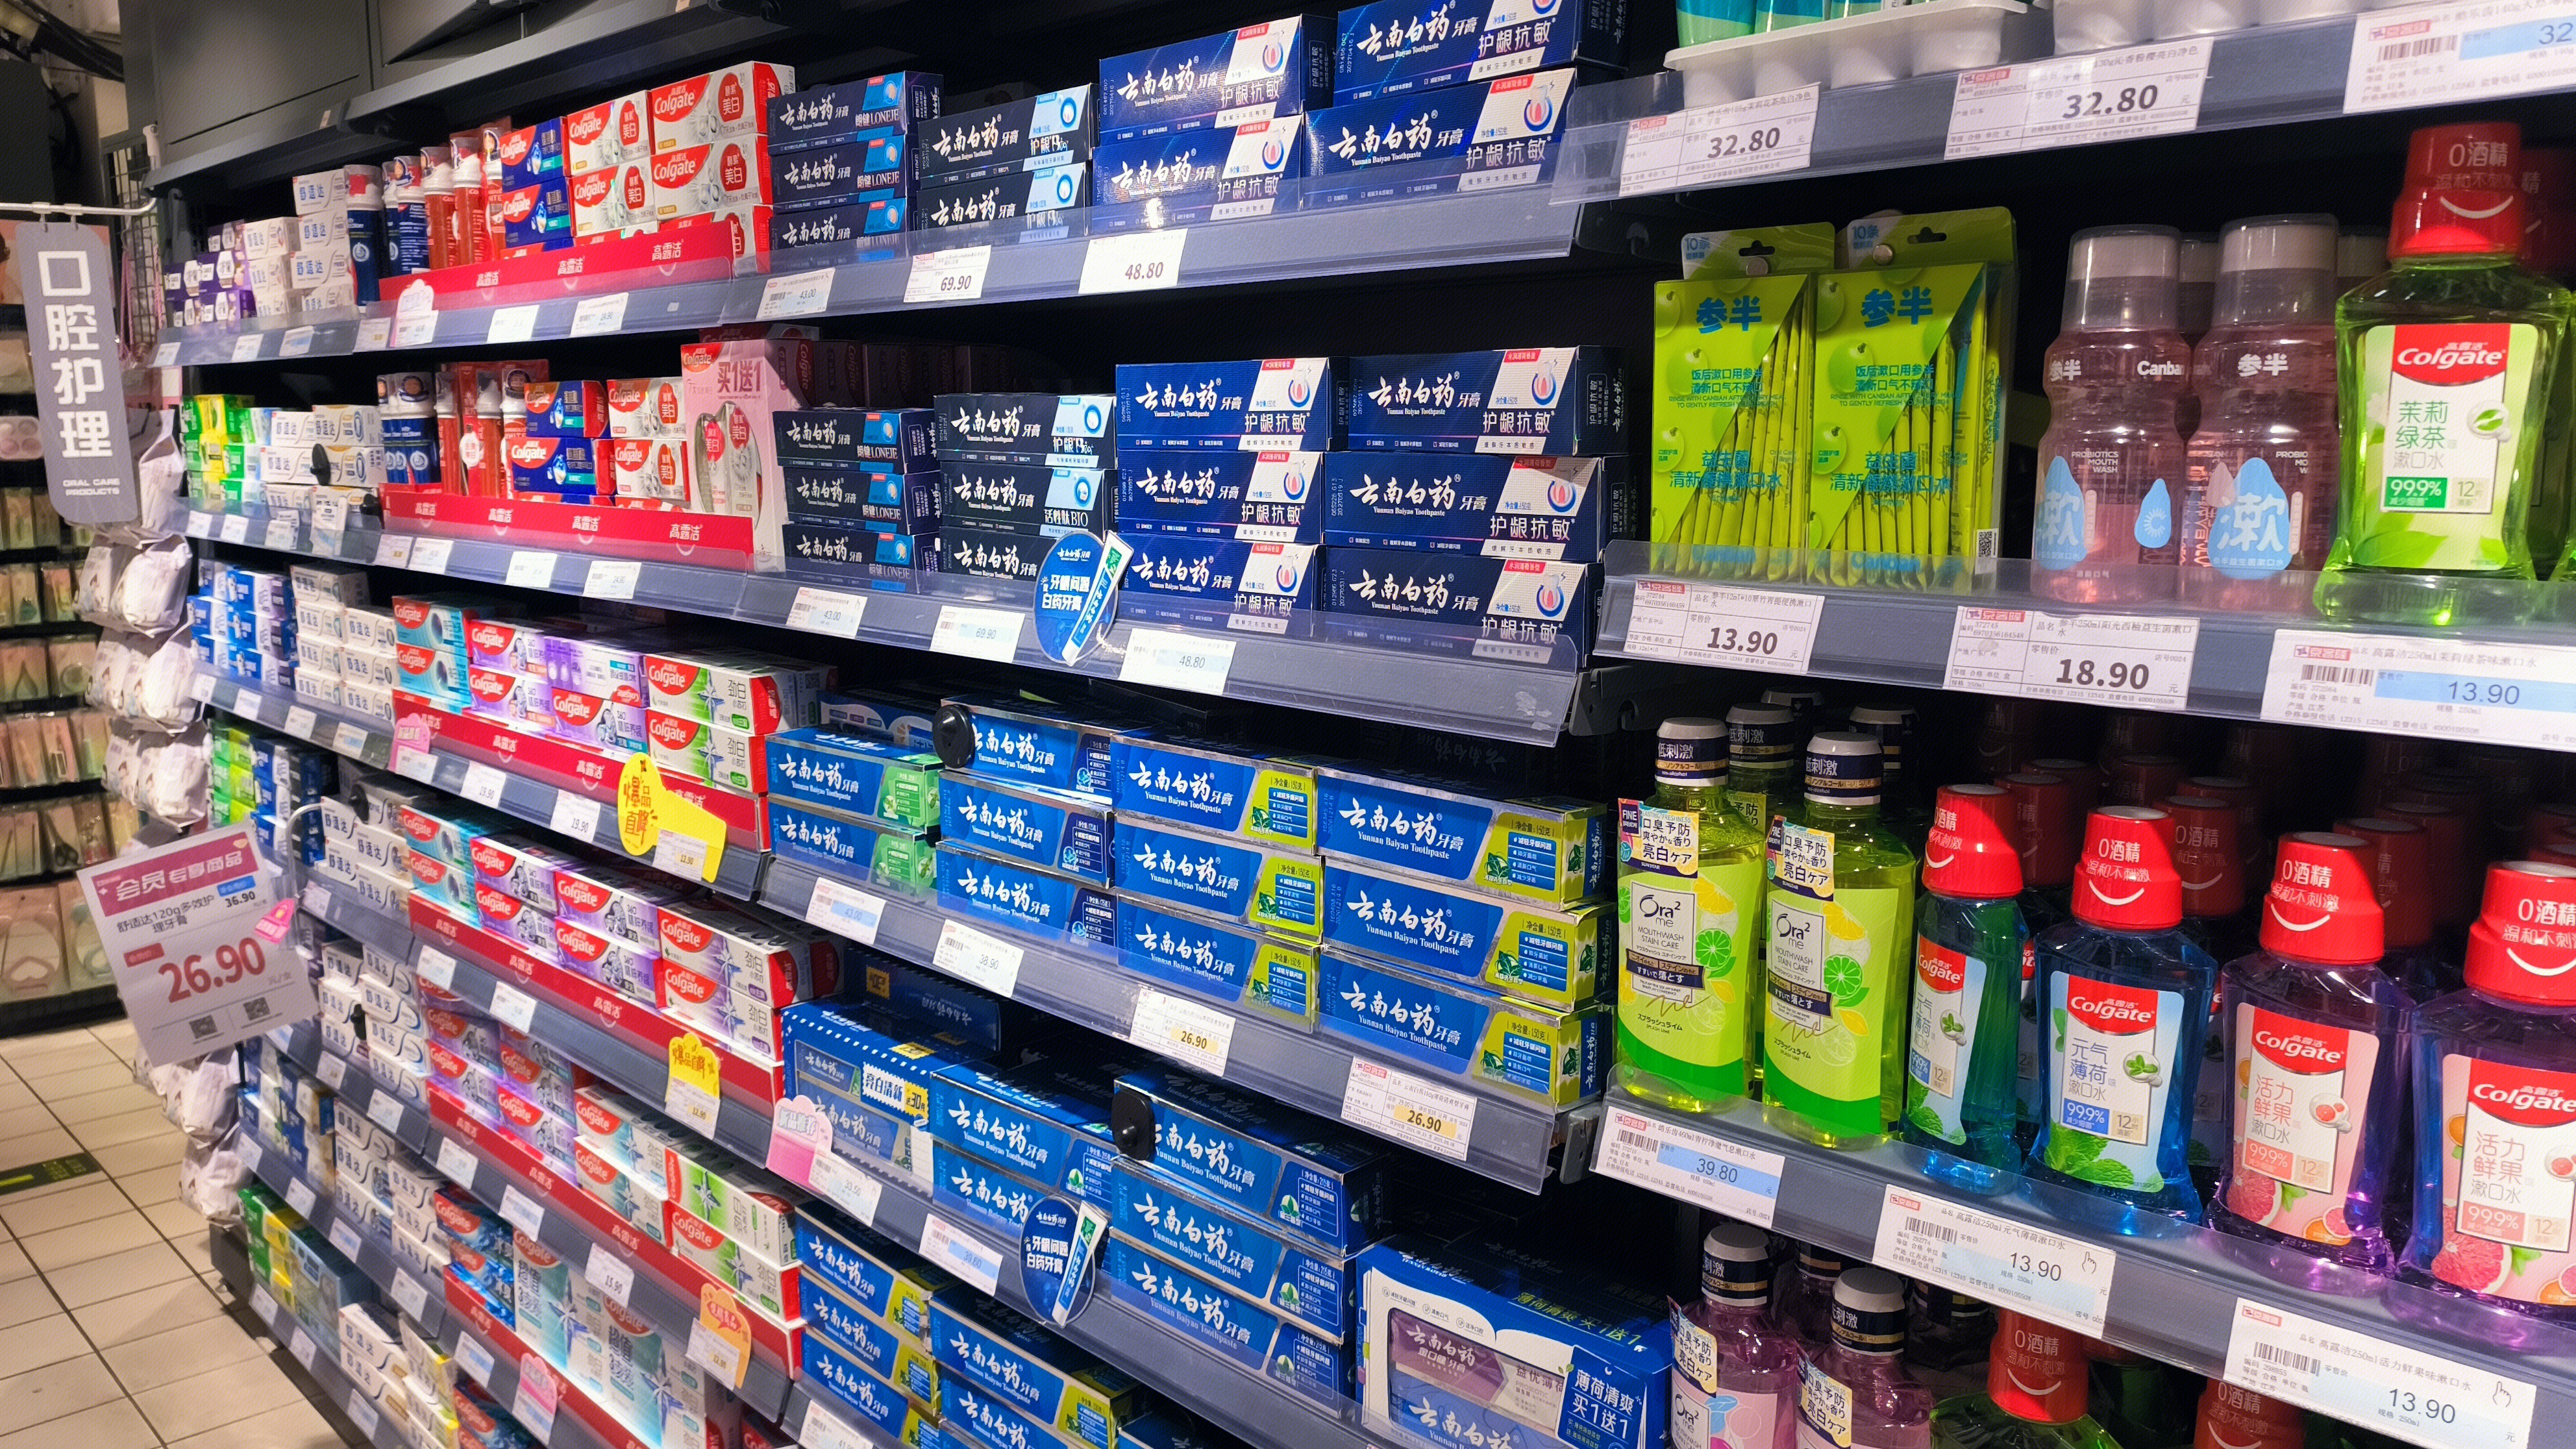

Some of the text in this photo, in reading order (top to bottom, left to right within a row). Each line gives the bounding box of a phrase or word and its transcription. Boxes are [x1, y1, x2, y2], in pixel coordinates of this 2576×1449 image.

[654, 91, 695, 116] Colgate
[2062, 86, 2158, 119] 32.80
[570, 118, 602, 139] Colgate
[1707, 127, 1780, 158] 32.80
[654, 160, 696, 181] Colgate
[574, 182, 606, 203] Colgate
[1124, 262, 1164, 279] 48.80
[799, 289, 817, 299] 43.00
[941, 276, 972, 292] 69.90
[1696, 296, 1762, 333] 参半
[1861, 286, 1933, 328] 参半
[38, 250, 113, 458] 口腔护理
[2238, 353, 2289, 378] 参半
[2397, 348, 2503, 369] Colgate
[2397, 400, 2449, 424] 茉莉
[2394, 425, 2446, 449] 绿茶
[511, 447, 547, 463] Colgate
[2393, 451, 2445, 469] 漱口水
[66, 488, 119, 496] PRODUCTS
[2391, 479, 2442, 497] 99.9%
[1373, 506, 1394, 514] Yunnan
[1415, 508, 1446, 517] Toothpaste
[824, 610, 841, 621] 43.00
[472, 634, 505, 649] Colgate
[976, 627, 997, 639] 69.90
[1707, 627, 1777, 654] 13.90
[1179, 656, 1206, 669] 48.80
[2056, 658, 2149, 689] 18.90
[649, 667, 686, 687] Colgate
[2449, 681, 2520, 705] 13.90
[1623, 810, 1637, 820] FINE
[1643, 819, 1690, 836] 口臭予防
[1643, 831, 1690, 847] 爽やかな香り
[1358, 831, 1450, 860] Yunnan Baiyao Toothpaste
[1643, 843, 1692, 864] 亮白ケア
[1785, 837, 1826, 858] 口臭予防
[2098, 839, 2140, 863] 0酒精
[1784, 862, 1827, 886] 亮白ケア
[2283, 860, 2333, 889] 0酒精
[224, 891, 256, 908] 36.90
[1638, 926, 1683, 941] MOUTHWASH
[1656, 917, 1674, 928] me
[661, 926, 700, 947] Colgate
[1642, 935, 1679, 950] STAIN CARE
[1775, 946, 1813, 965] MOUTHWASH
[158, 937, 265, 1003] 26.90
[1637, 966, 1684, 983] すすいで落とす
[1918, 954, 1963, 984] Colgate
[2070, 995, 2152, 1023] Colgate
[1181, 1031, 1207, 1049] 26.90
[2072, 1037, 2109, 1064] 元气
[2255, 1030, 2341, 1063] Colgate
[2070, 1061, 2107, 1085] 薄荷
[2068, 1080, 2106, 1102] 漱口水
[2255, 1074, 2294, 1104] 活力
[1407, 1109, 1441, 1132] 26.90
[2066, 1102, 2105, 1124] 99.9%
[2253, 1100, 2292, 1124] 鲜果
[2249, 1143, 2288, 1168] 99.9%
[2475, 1132, 2525, 1159] 活力
[1696, 1158, 1738, 1183] 39.80
[2473, 1156, 2523, 1183] 鲜果
[2467, 1204, 2519, 1231] 99.9%
[673, 1217, 715, 1245] Colgate
[1152, 1228, 1241, 1280] Yunnan Baiyao Toothpaste
[2011, 1252, 2062, 1282] 13.90
[2015, 1328, 2059, 1356] 0酒精
[1576, 1369, 1634, 1415] 薄荷清爽
[2390, 1388, 2456, 1424] 13.90
